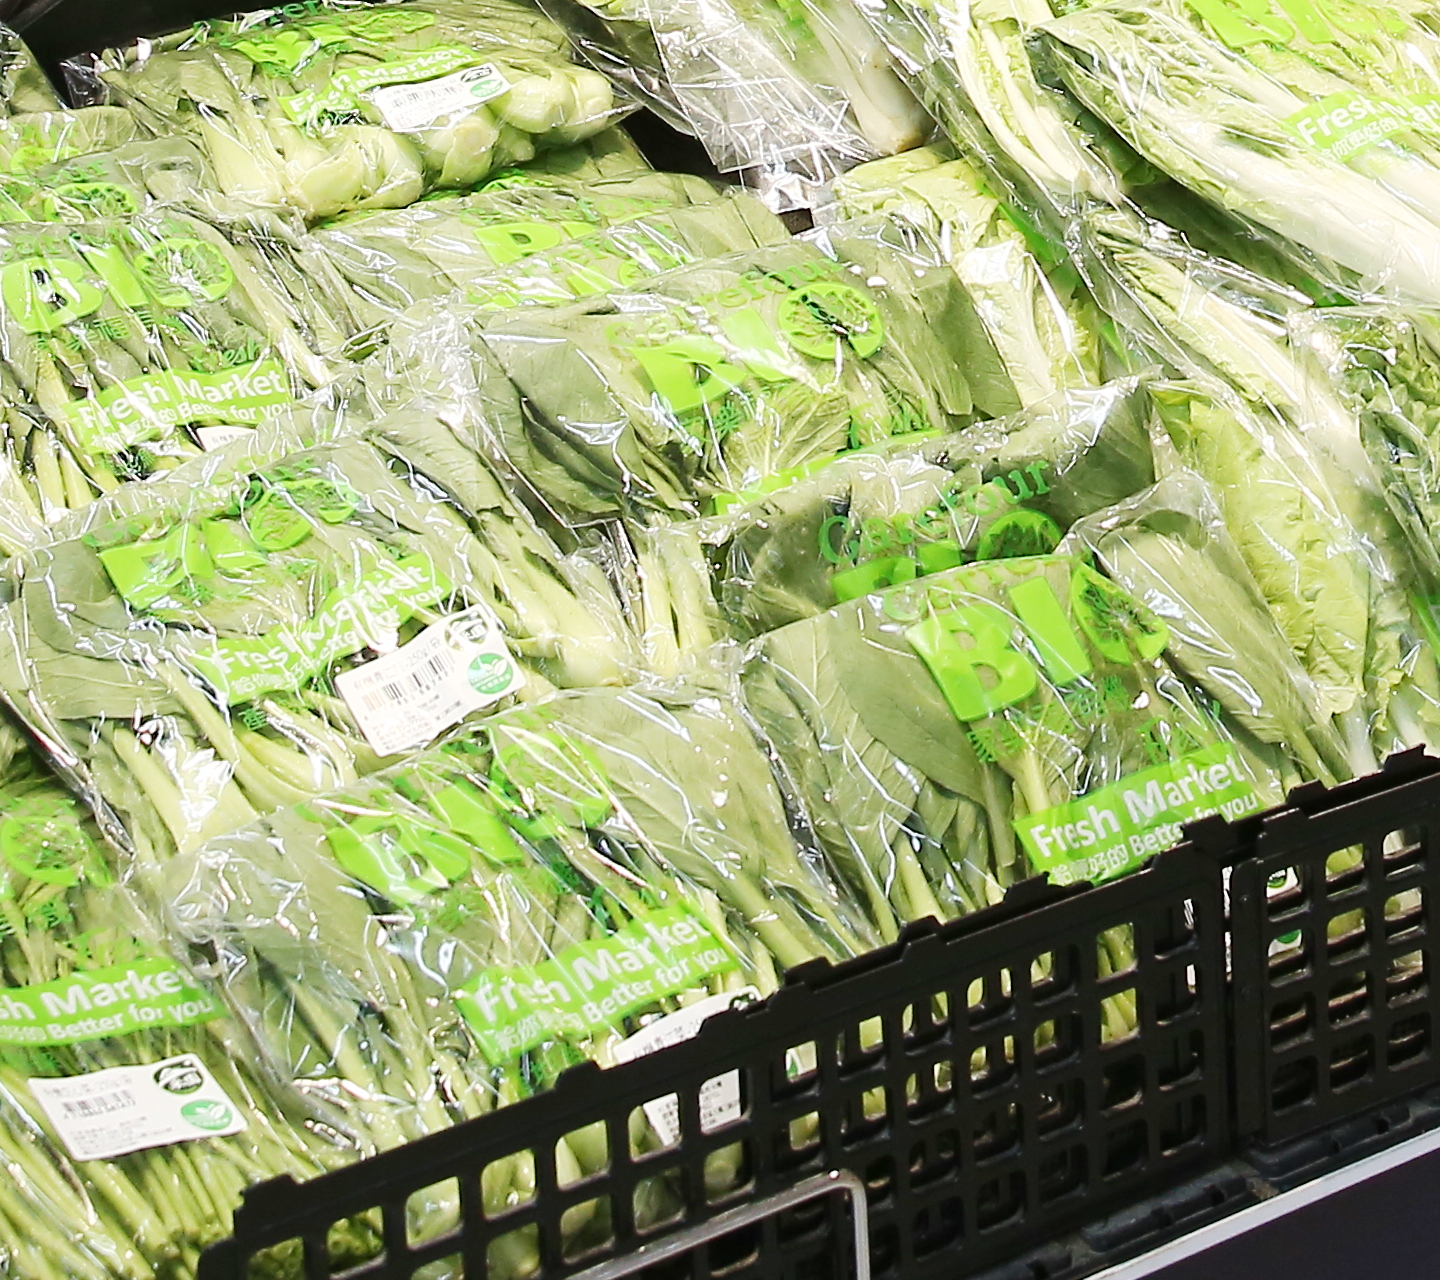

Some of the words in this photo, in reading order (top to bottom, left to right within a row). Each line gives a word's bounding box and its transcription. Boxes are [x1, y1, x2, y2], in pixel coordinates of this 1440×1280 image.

[0, 237, 236, 335] BIO
[172, 370, 285, 404] Market
[904, 561, 1173, 724] BIO
[1029, 803, 1121, 859] Fresh
[1121, 752, 1249, 826] Market
[472, 974, 571, 1025] Fresh
[570, 911, 713, 991] Market
[581, 980, 655, 1026] Better
[657, 964, 690, 994] for
[690, 948, 730, 978] you
[45, 1013, 125, 1040] Better
